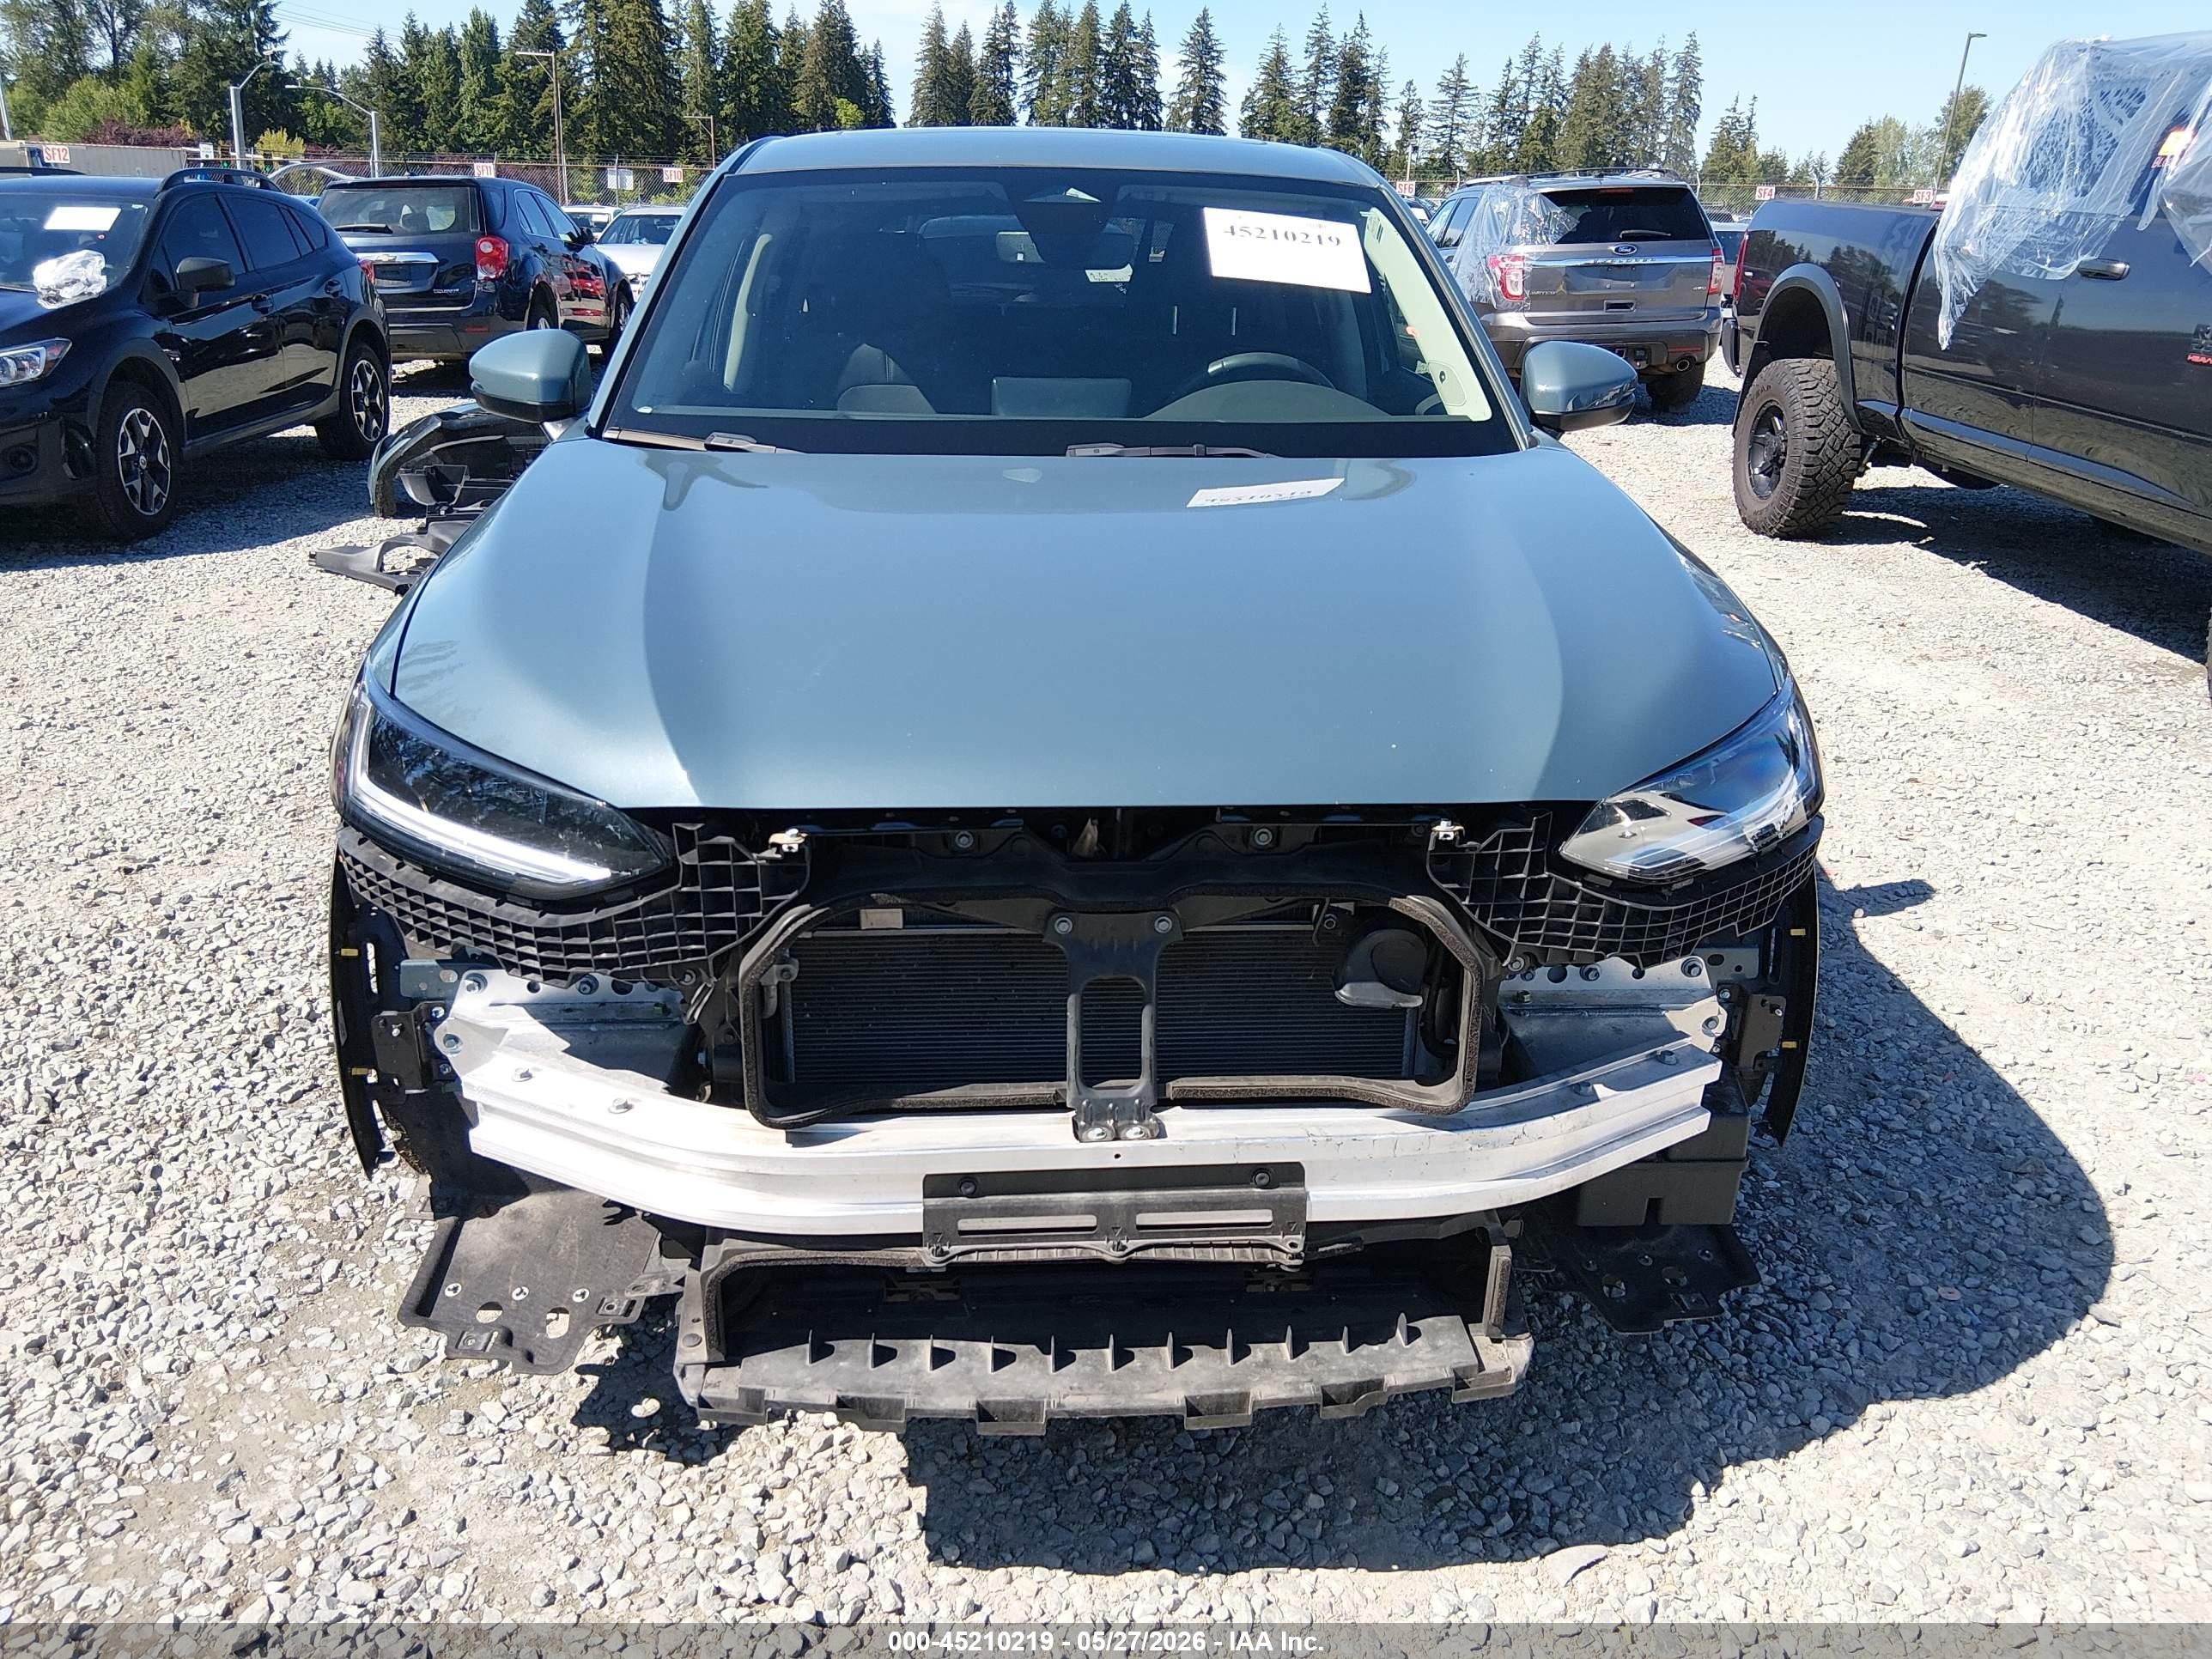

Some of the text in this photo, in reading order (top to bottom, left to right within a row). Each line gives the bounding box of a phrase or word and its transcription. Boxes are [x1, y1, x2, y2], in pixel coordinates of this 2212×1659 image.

[44, 147, 70, 161] SF12
[664, 169, 683, 180] SF10
[1397, 182, 1414, 194] SF6
[1757, 187, 1773, 199] SF4
[1915, 191, 1932, 202] SF3
[1224, 224, 1341, 246] 45210219
